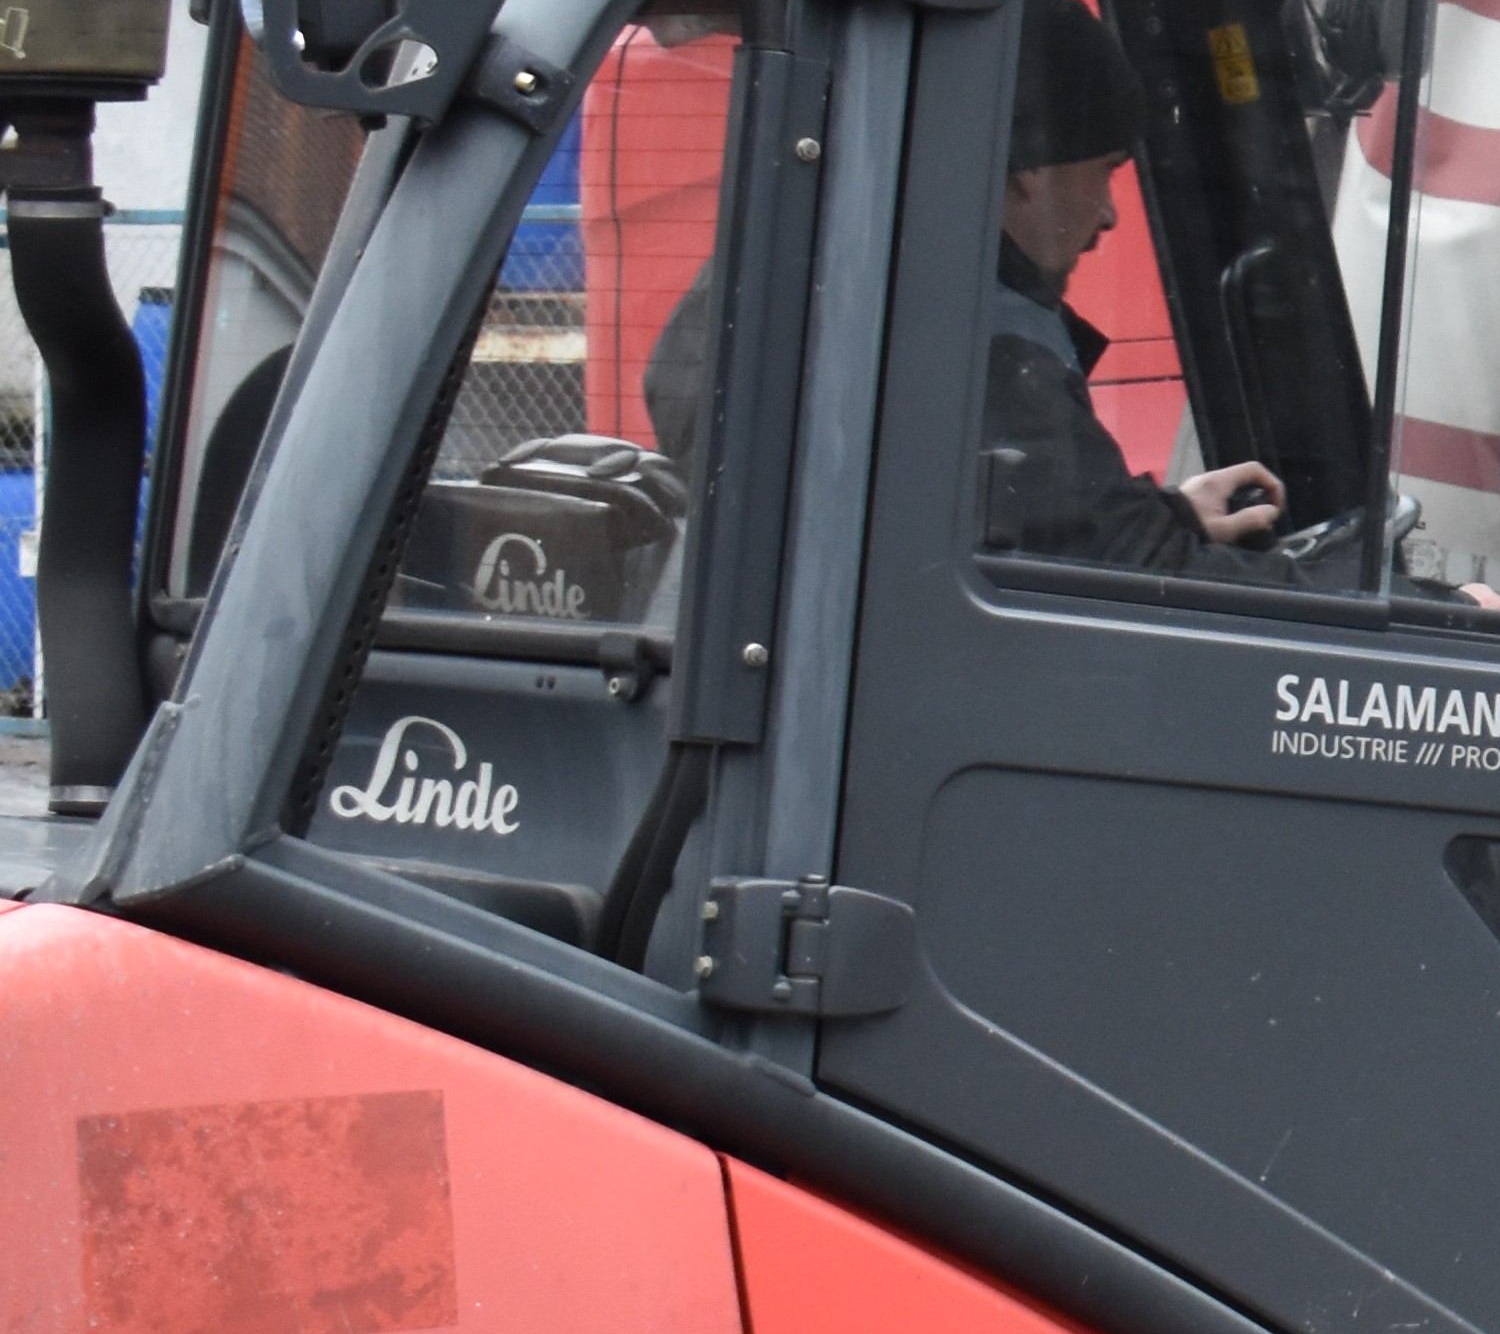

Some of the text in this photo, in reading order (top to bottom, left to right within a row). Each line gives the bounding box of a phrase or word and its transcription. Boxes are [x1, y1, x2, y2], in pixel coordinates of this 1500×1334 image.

[473, 532, 588, 620] Linde
[329, 716, 520, 835] Linde
[1271, 730, 1409, 763] INDUSTRIE
